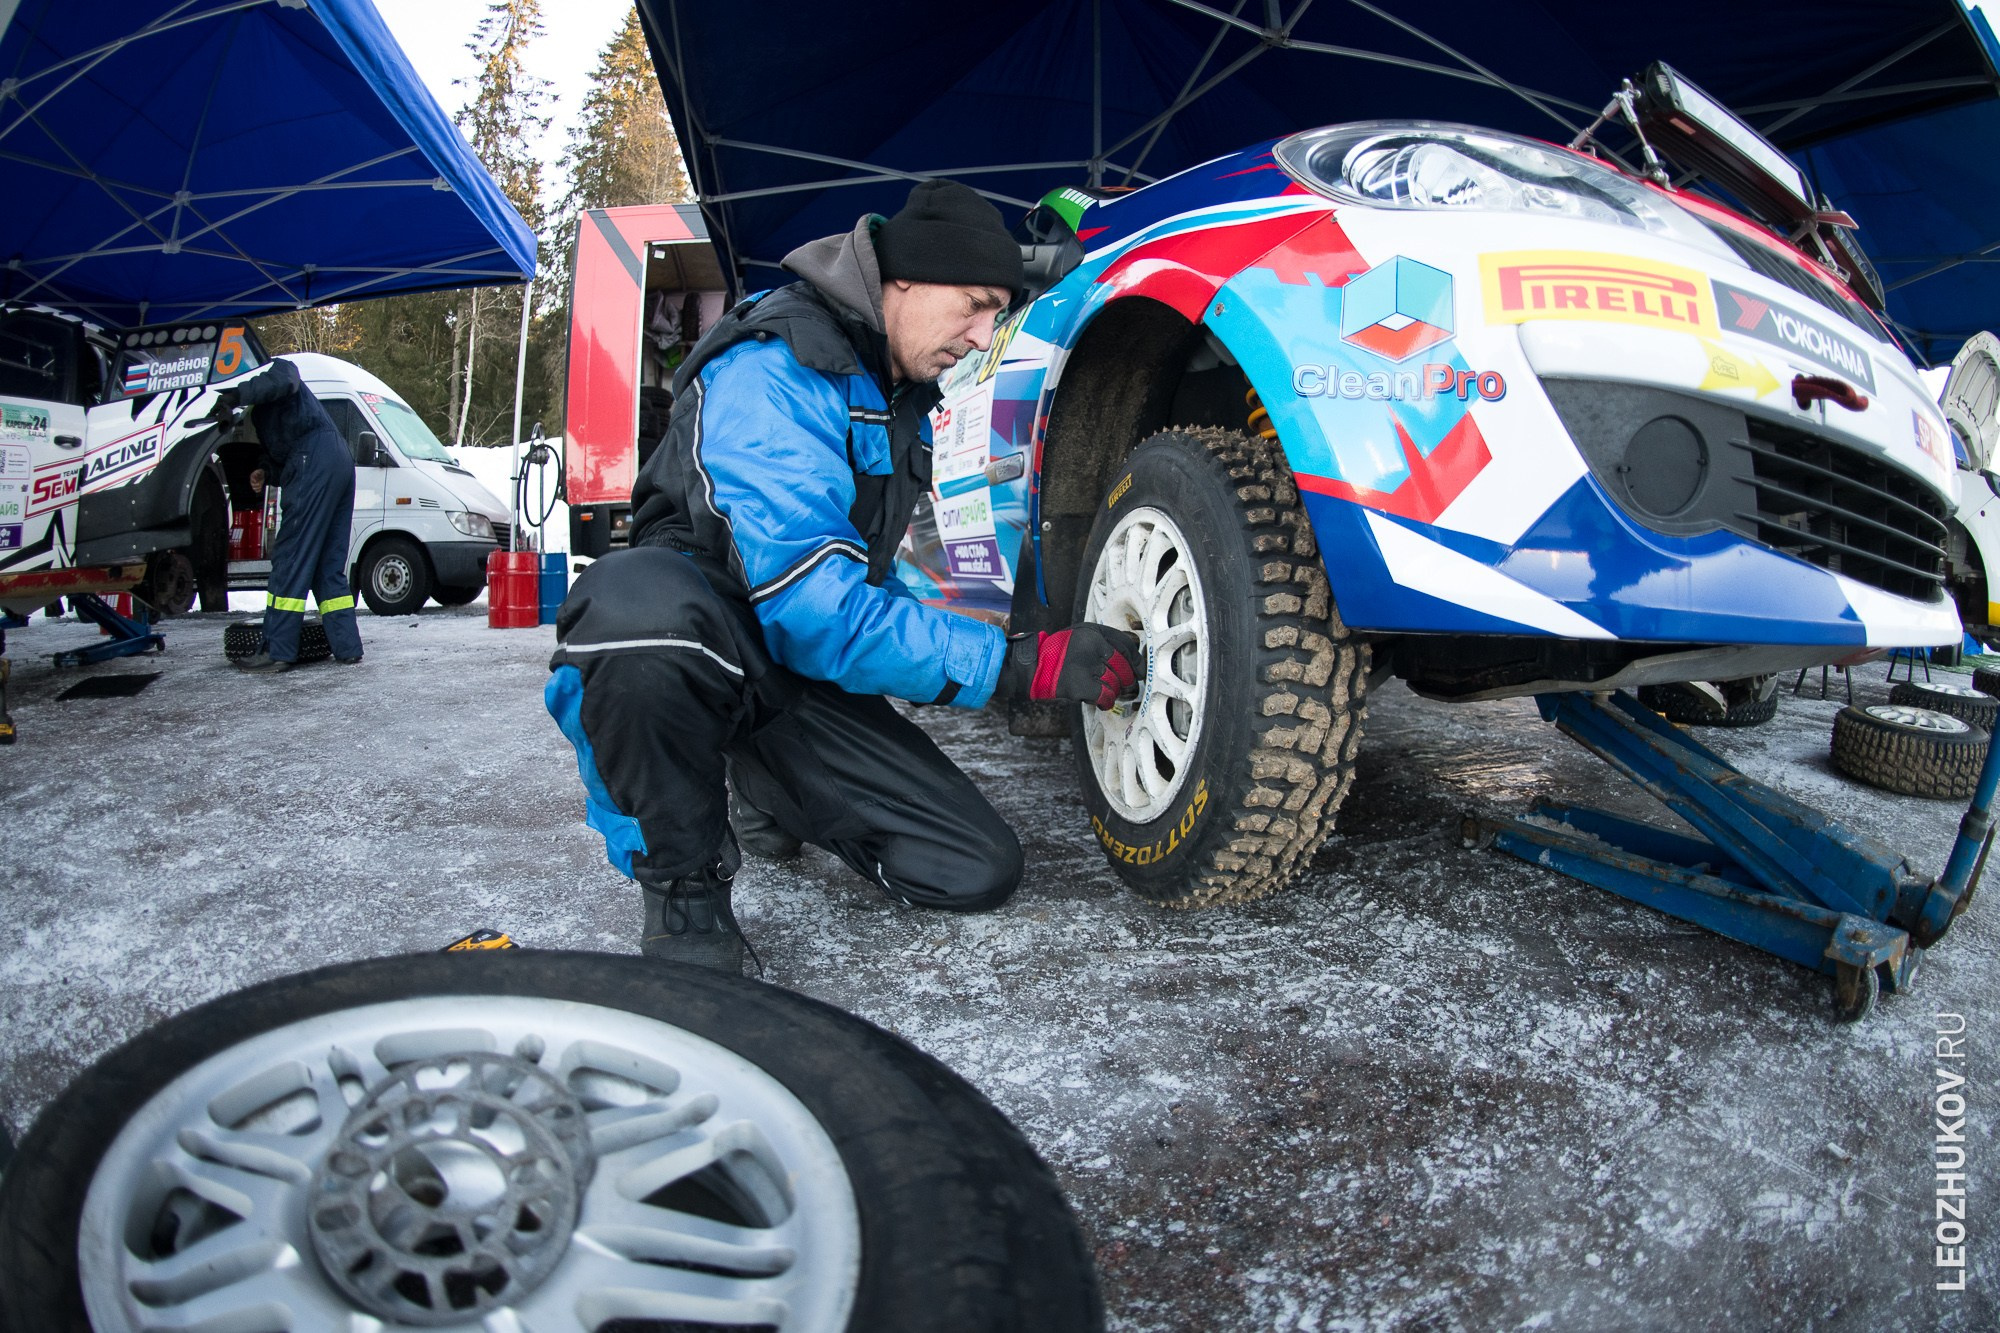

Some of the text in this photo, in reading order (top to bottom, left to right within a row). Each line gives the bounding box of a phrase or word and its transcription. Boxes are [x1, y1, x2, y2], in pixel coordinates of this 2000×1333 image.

[1498, 264, 1699, 326] PIRELLI
[217, 328, 245, 375] 5
[1769, 308, 1869, 383] YOKOHAMA
[147, 372, 204, 392] Игнатов
[149, 356, 210, 377] Семёнов
[1292, 363, 1507, 401] CleanPro
[63, 468, 79, 478] TEAM
[1108, 472, 1132, 509] PIRELLI
[943, 499, 987, 529] СИТИДРАЙВ
[1092, 778, 1208, 865] SOTTOZERO
